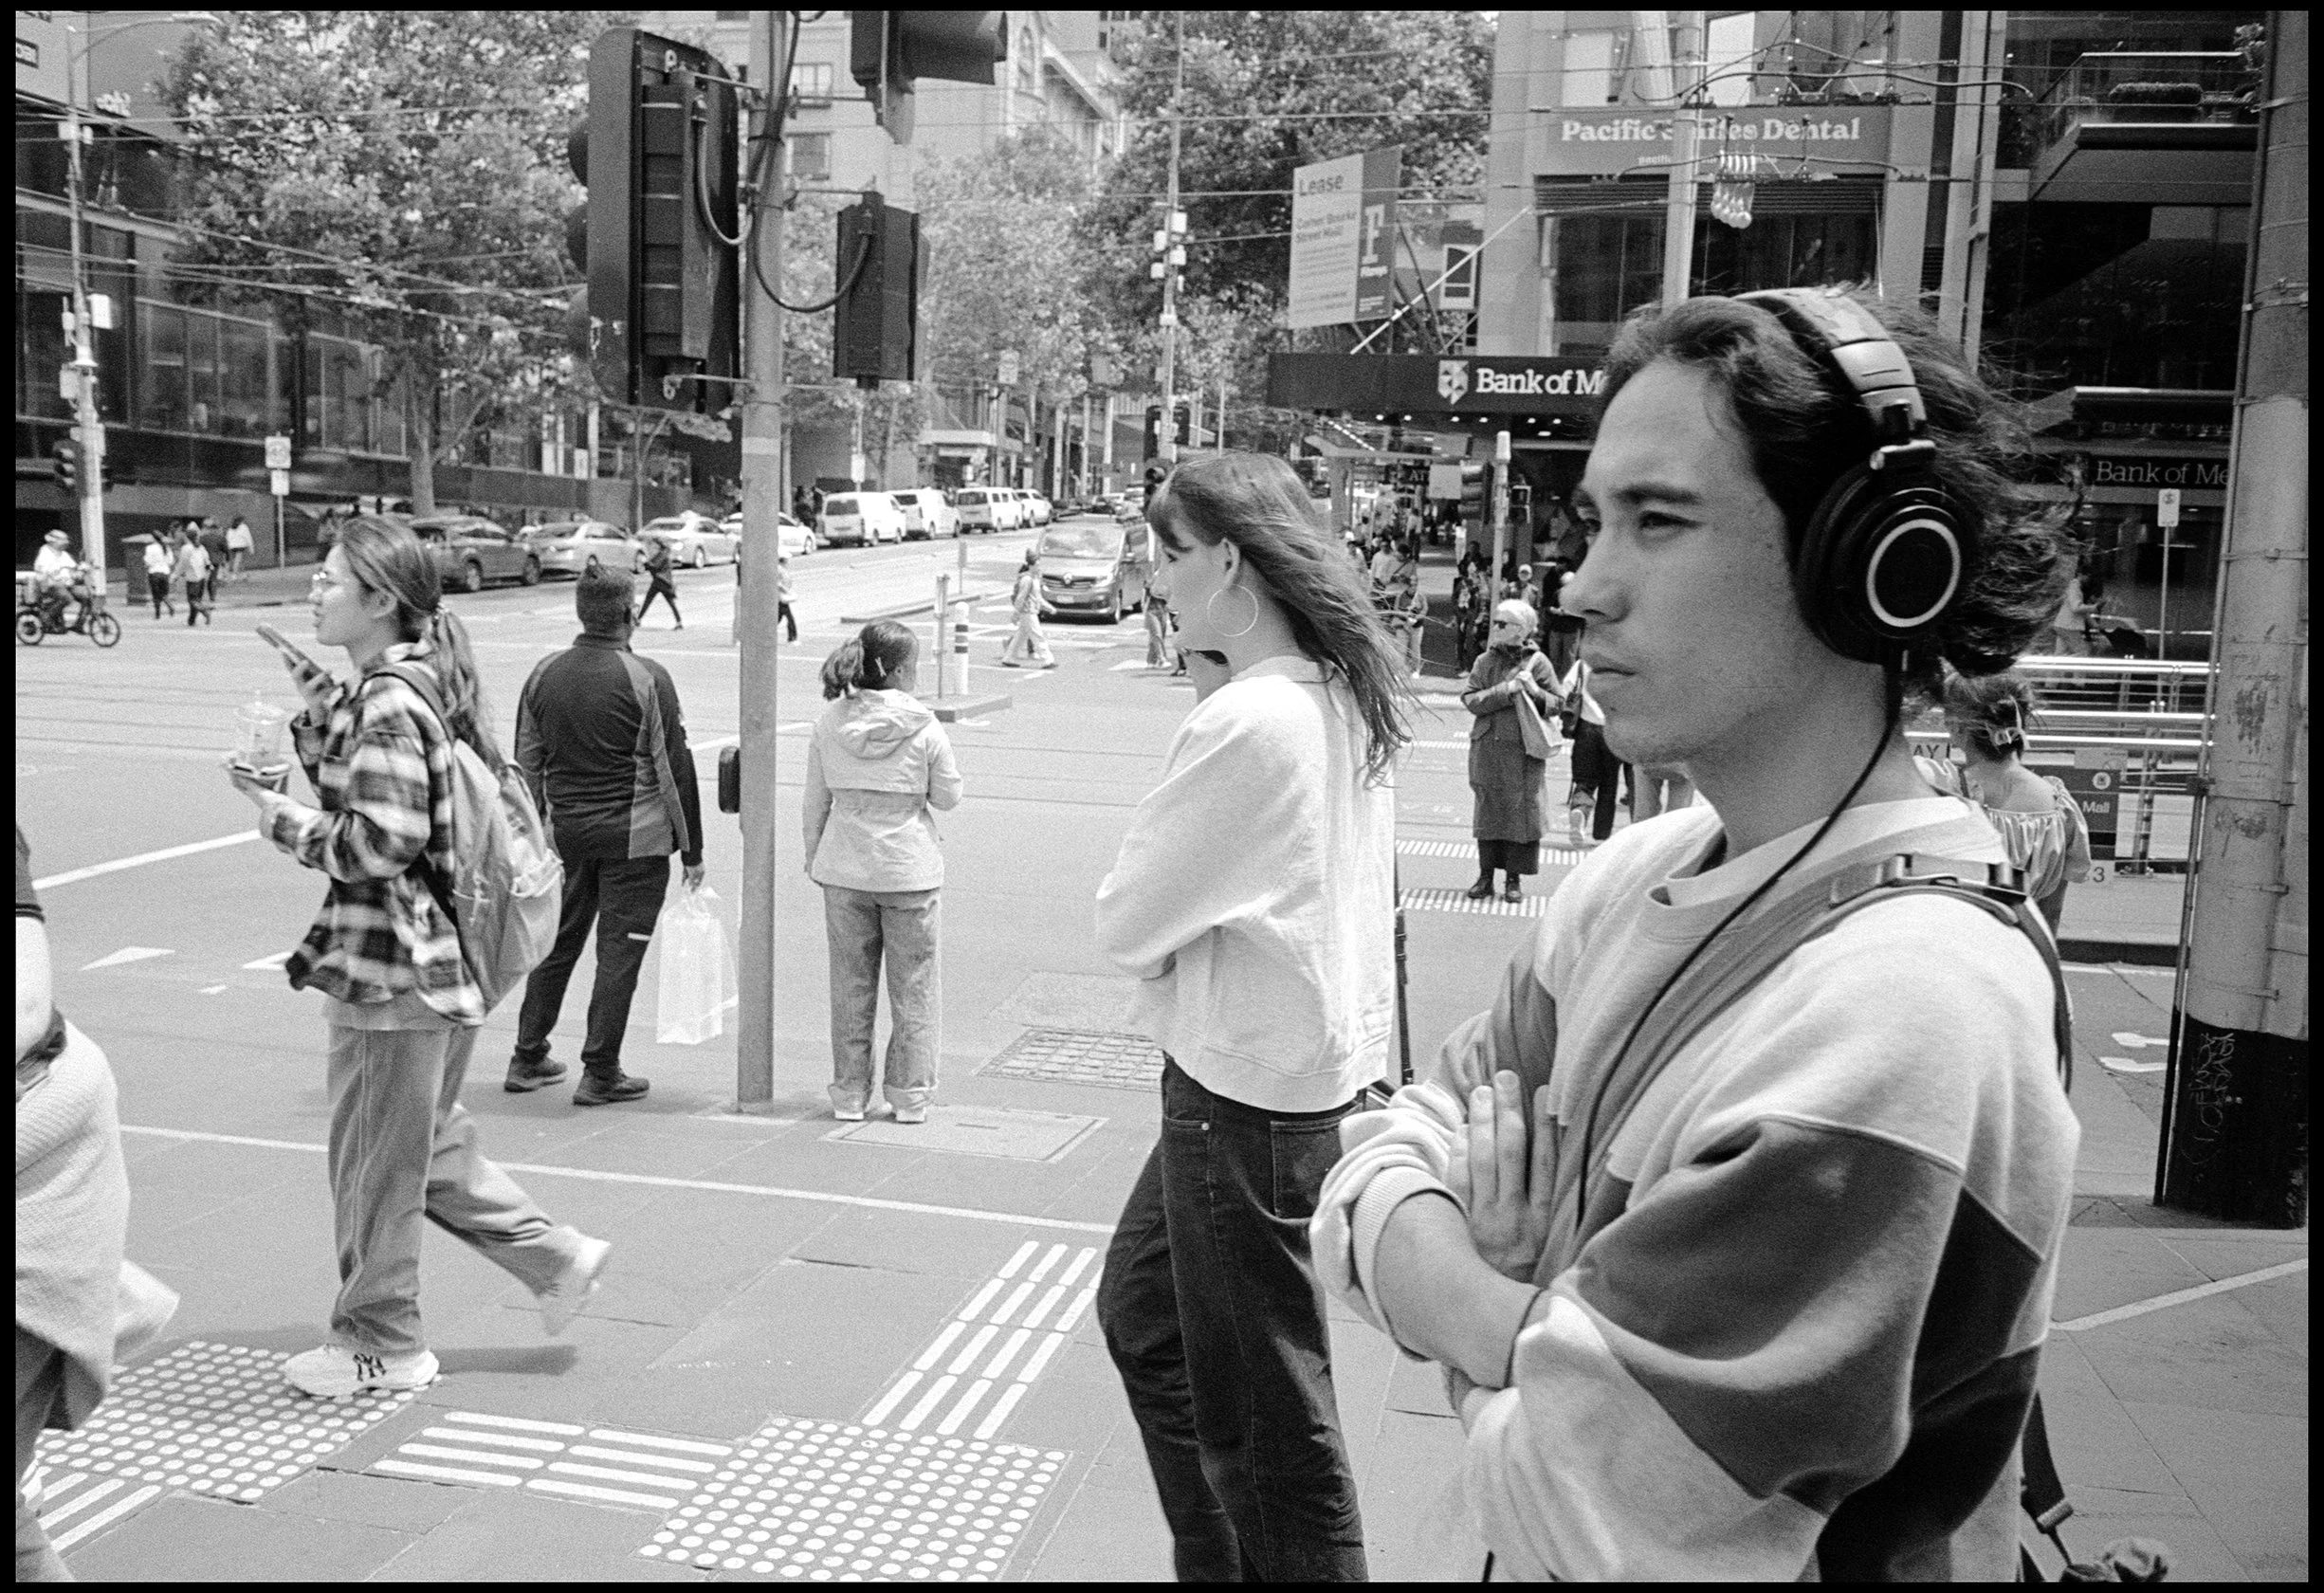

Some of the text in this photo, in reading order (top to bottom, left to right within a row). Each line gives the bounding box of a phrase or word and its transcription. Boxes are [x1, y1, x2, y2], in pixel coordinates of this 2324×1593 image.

[1562, 119, 1656, 141] Pacific
[1763, 117, 1861, 140] Dental
[1299, 174, 1345, 196] Lease
[1475, 368, 1543, 394] Bank
[1545, 369, 1572, 394] of
[2096, 460, 2160, 483] Bank
[2165, 463, 2190, 484] of
[2083, 800, 2110, 814] Mall
[2093, 867, 2105, 883] 3
